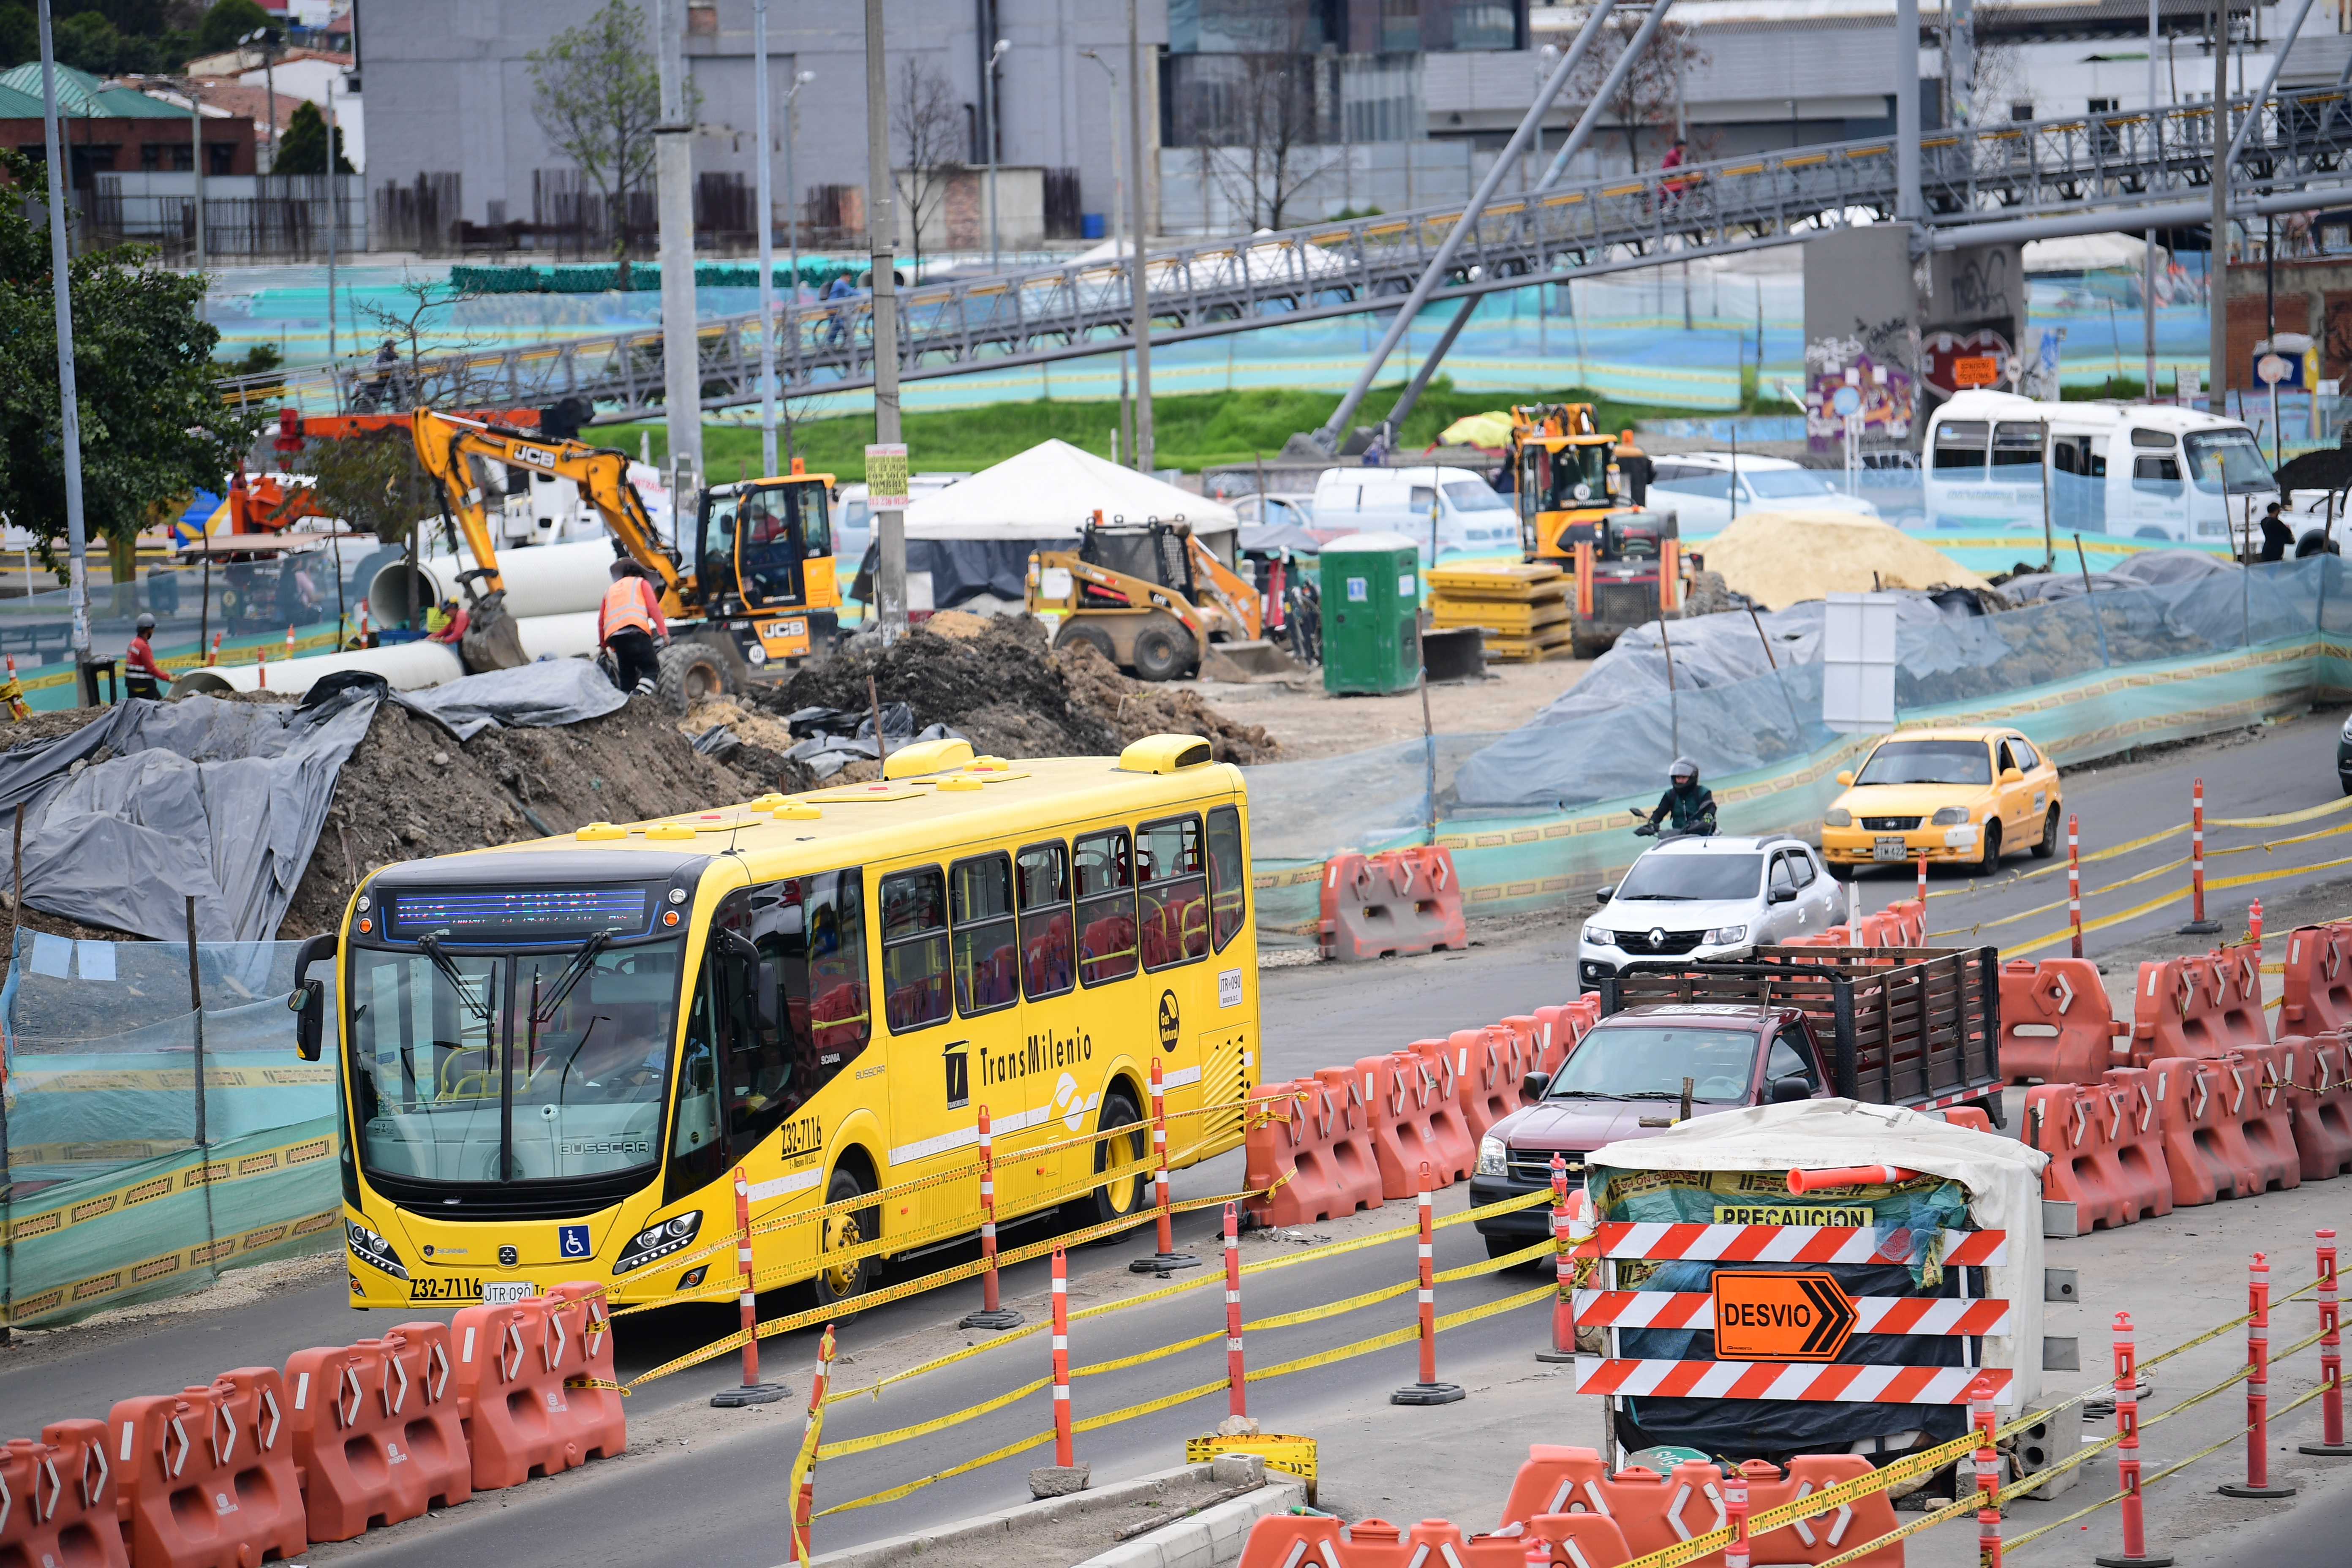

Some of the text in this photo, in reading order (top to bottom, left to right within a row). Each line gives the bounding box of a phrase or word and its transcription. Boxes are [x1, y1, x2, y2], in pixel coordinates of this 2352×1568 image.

[514, 445, 555, 468] JCB
[763, 621, 804, 639] JCB
[753, 649, 761, 659] 40
[1220, 975, 1241, 992] JTR 090
[1161, 1012, 1170, 1026] Gas
[1162, 1024, 1178, 1043] Natural
[821, 1053, 841, 1065] SCANIA
[980, 1026, 1091, 1086] TransMilenio
[855, 1065, 885, 1080] BUSSCAR
[947, 1098, 969, 1109] TRANSMILENIO
[781, 1115, 822, 1155] Z32-7116
[291, 1149, 306, 1159] PELIGRO
[313, 1145, 324, 1154] PASE
[558, 1141, 649, 1155] BUSSCAR
[243, 1161, 256, 1170] PELIGRO
[794, 1157, 804, 1168] Masivo
[190, 1170, 208, 1181] PELIGRO
[216, 1168, 224, 1176] PASE
[1636, 1175, 1651, 1186] NO
[1654, 1171, 1697, 1181] PELIGRO
[130, 1182, 165, 1200] PELIGRO NO PASE
[76, 1200, 110, 1217] PELIGRO NO PASE
[1723, 1208, 1864, 1227] PRECAUCION
[18, 1217, 54, 1234] PELIGRO NO PASE
[409, 1278, 482, 1298] Z32-7116
[485, 1287, 506, 1301] JTR
[509, 1287, 531, 1301] 090
[1725, 1304, 1811, 1327] DESVIO
